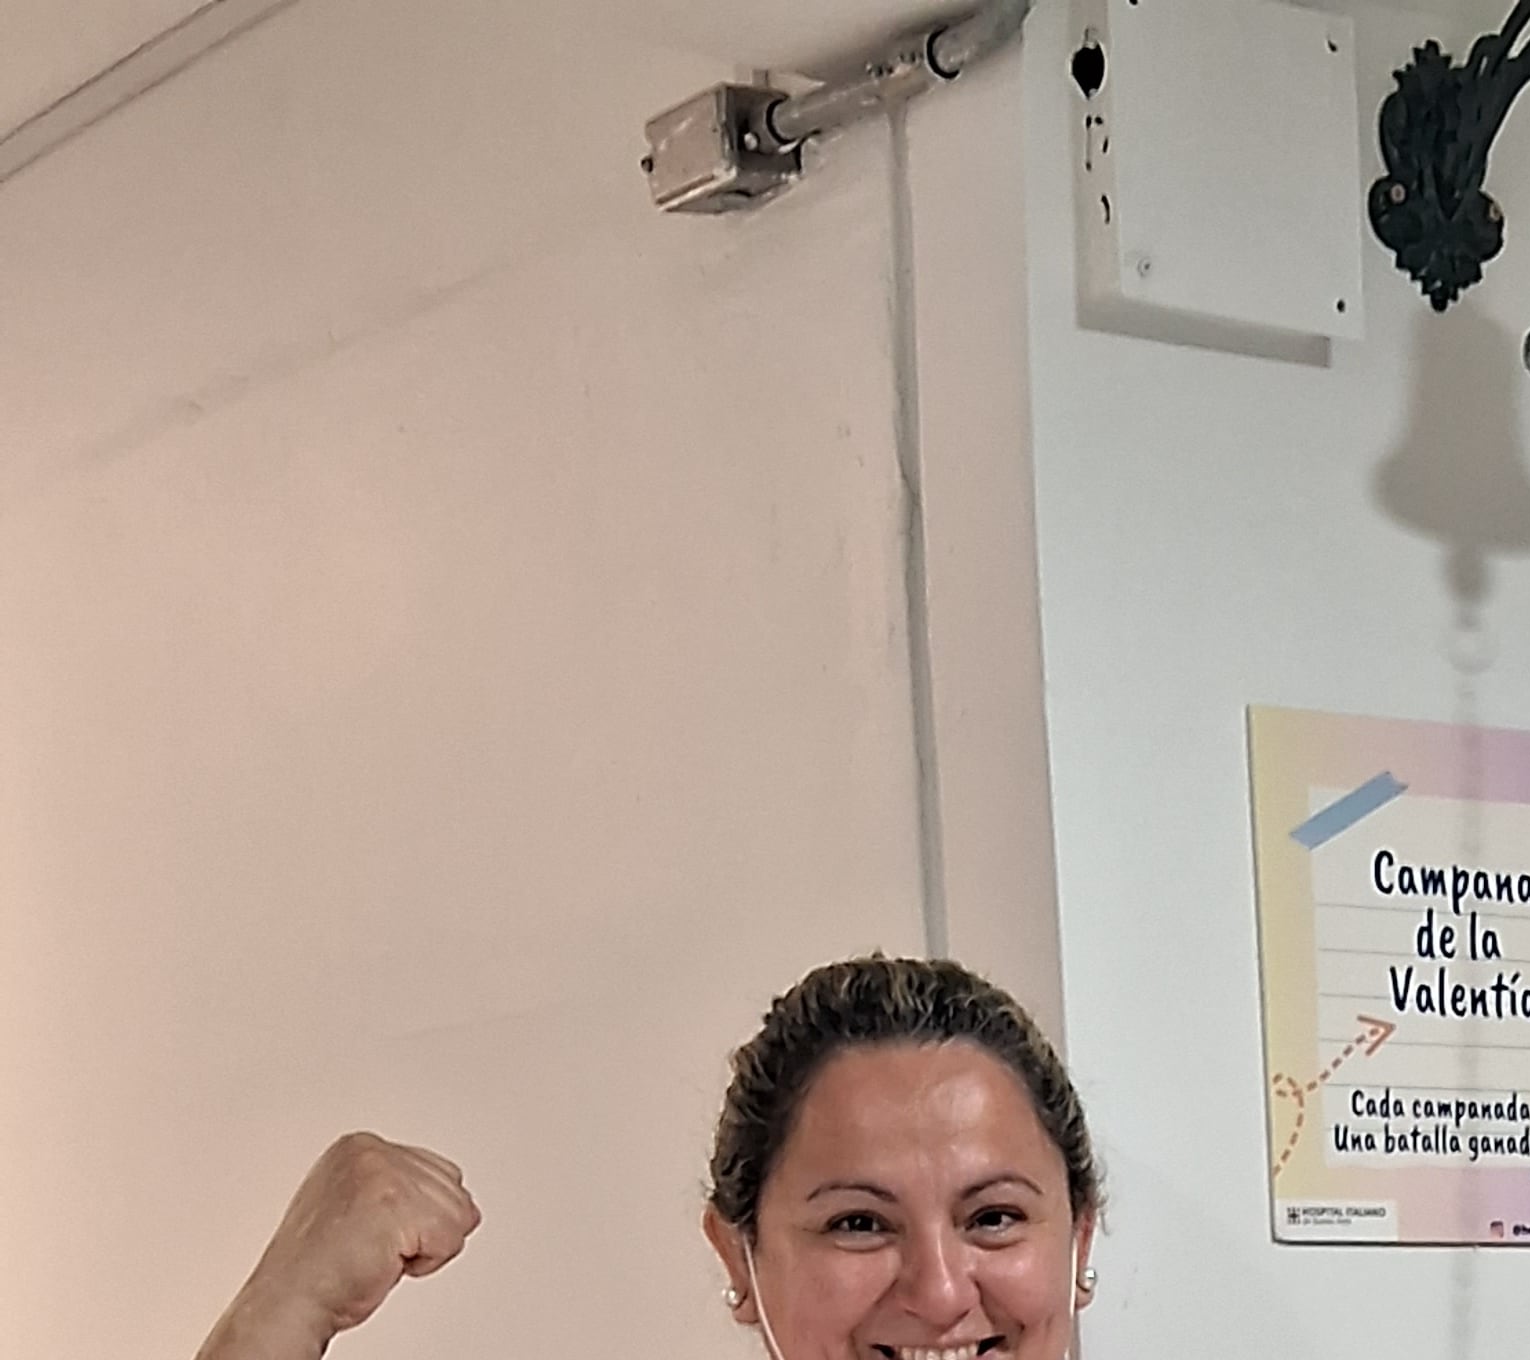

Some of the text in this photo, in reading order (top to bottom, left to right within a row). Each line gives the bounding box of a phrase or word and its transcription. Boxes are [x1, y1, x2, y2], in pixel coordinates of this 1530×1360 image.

[1416, 907, 1502, 962] de la
[1351, 1087, 1405, 1119] Cada
[1334, 1124, 1377, 1152] Una
[1384, 1123, 1462, 1154] batalla
